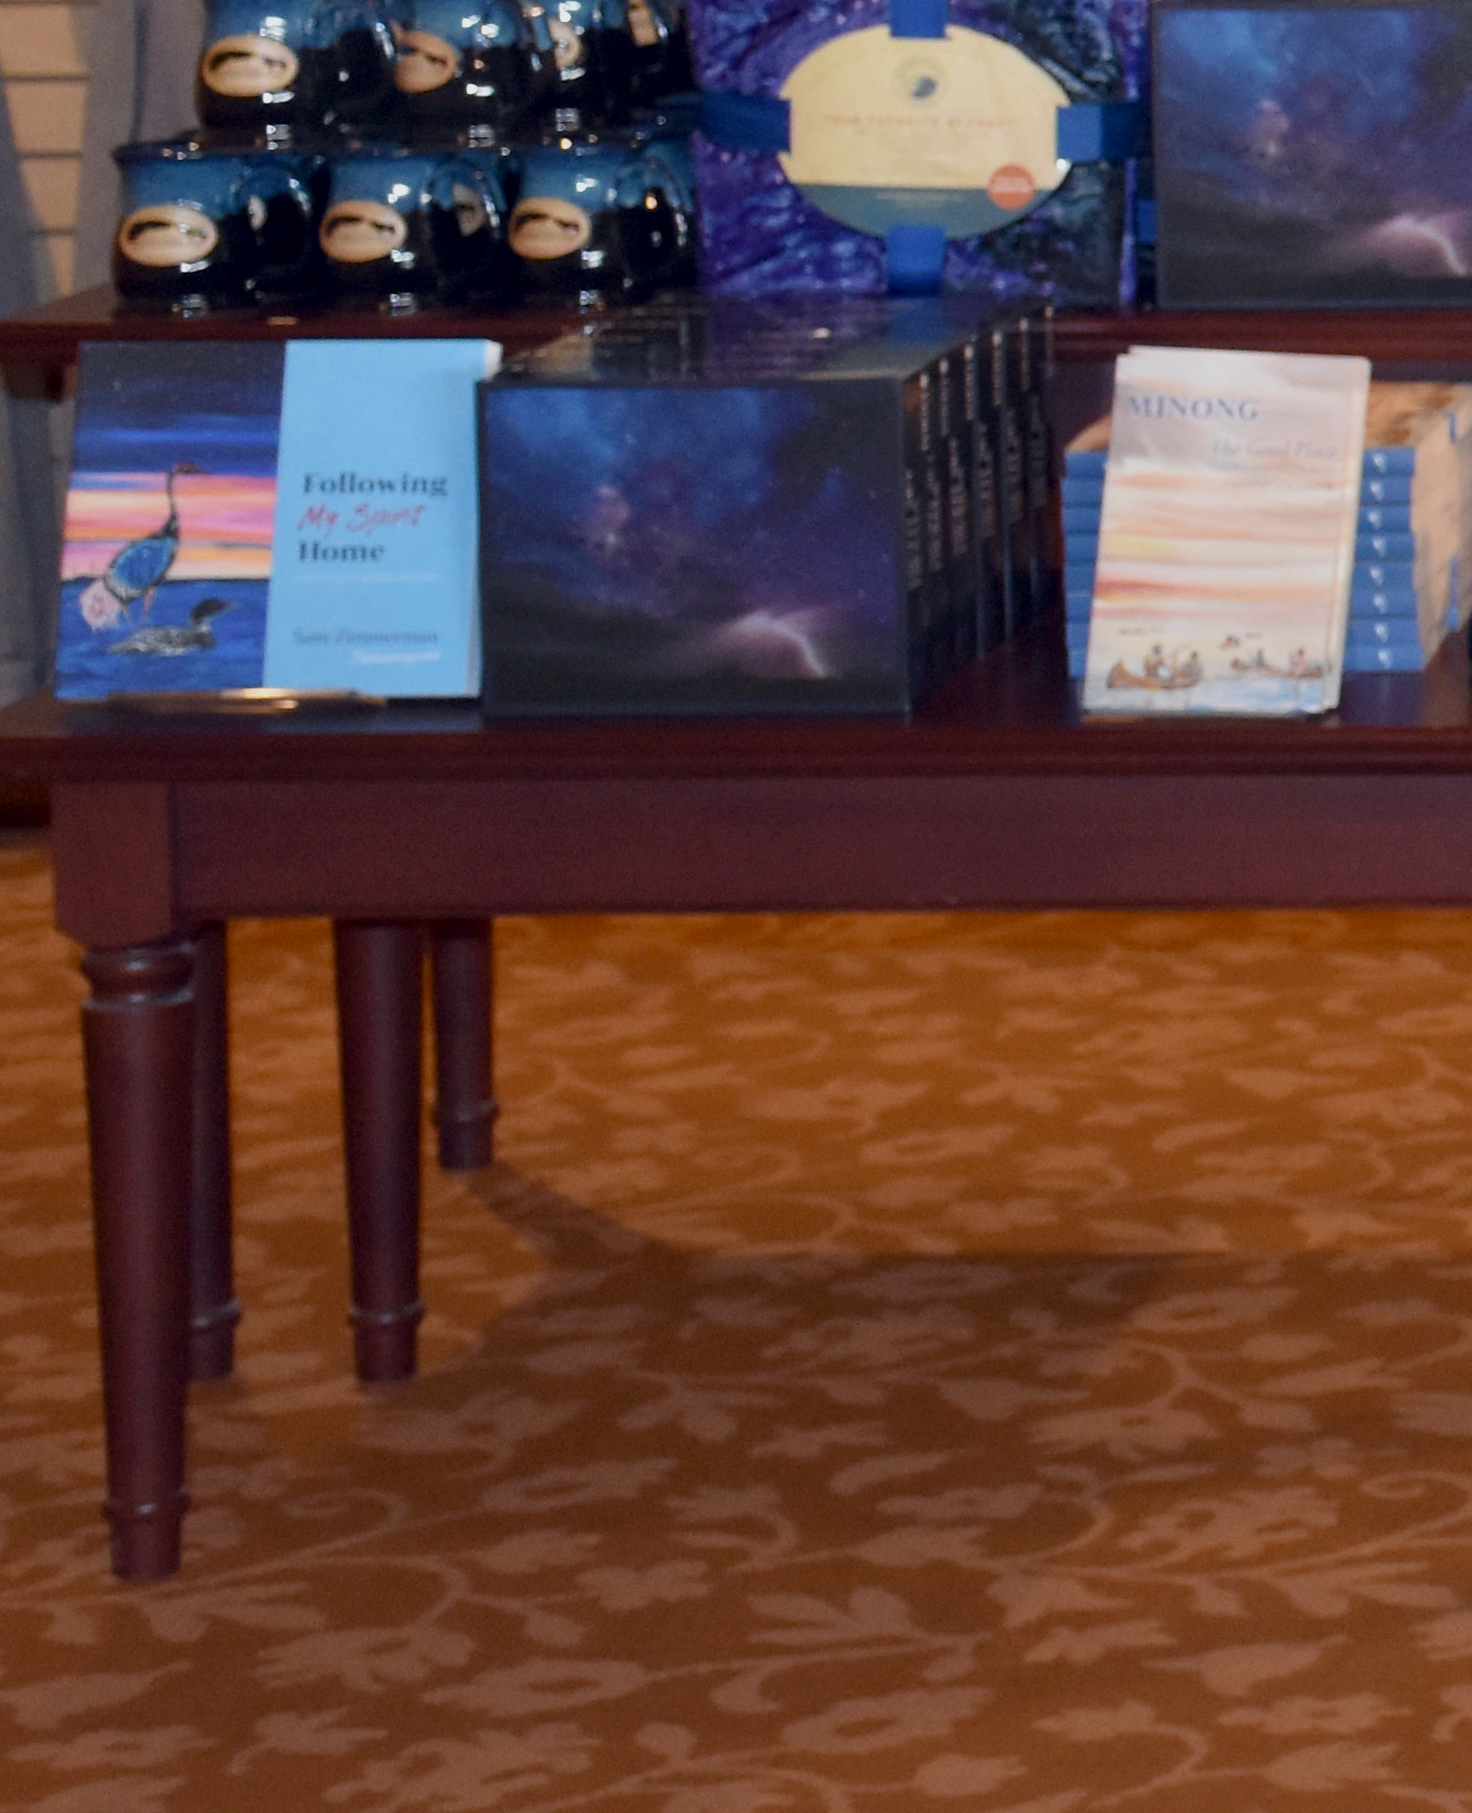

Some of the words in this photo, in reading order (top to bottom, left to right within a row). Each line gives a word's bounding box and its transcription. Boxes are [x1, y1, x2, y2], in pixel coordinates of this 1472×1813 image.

[1128, 394, 1259, 421] MINONG
[302, 471, 448, 498] Following
[298, 503, 341, 539] My
[299, 538, 385, 563] Home
